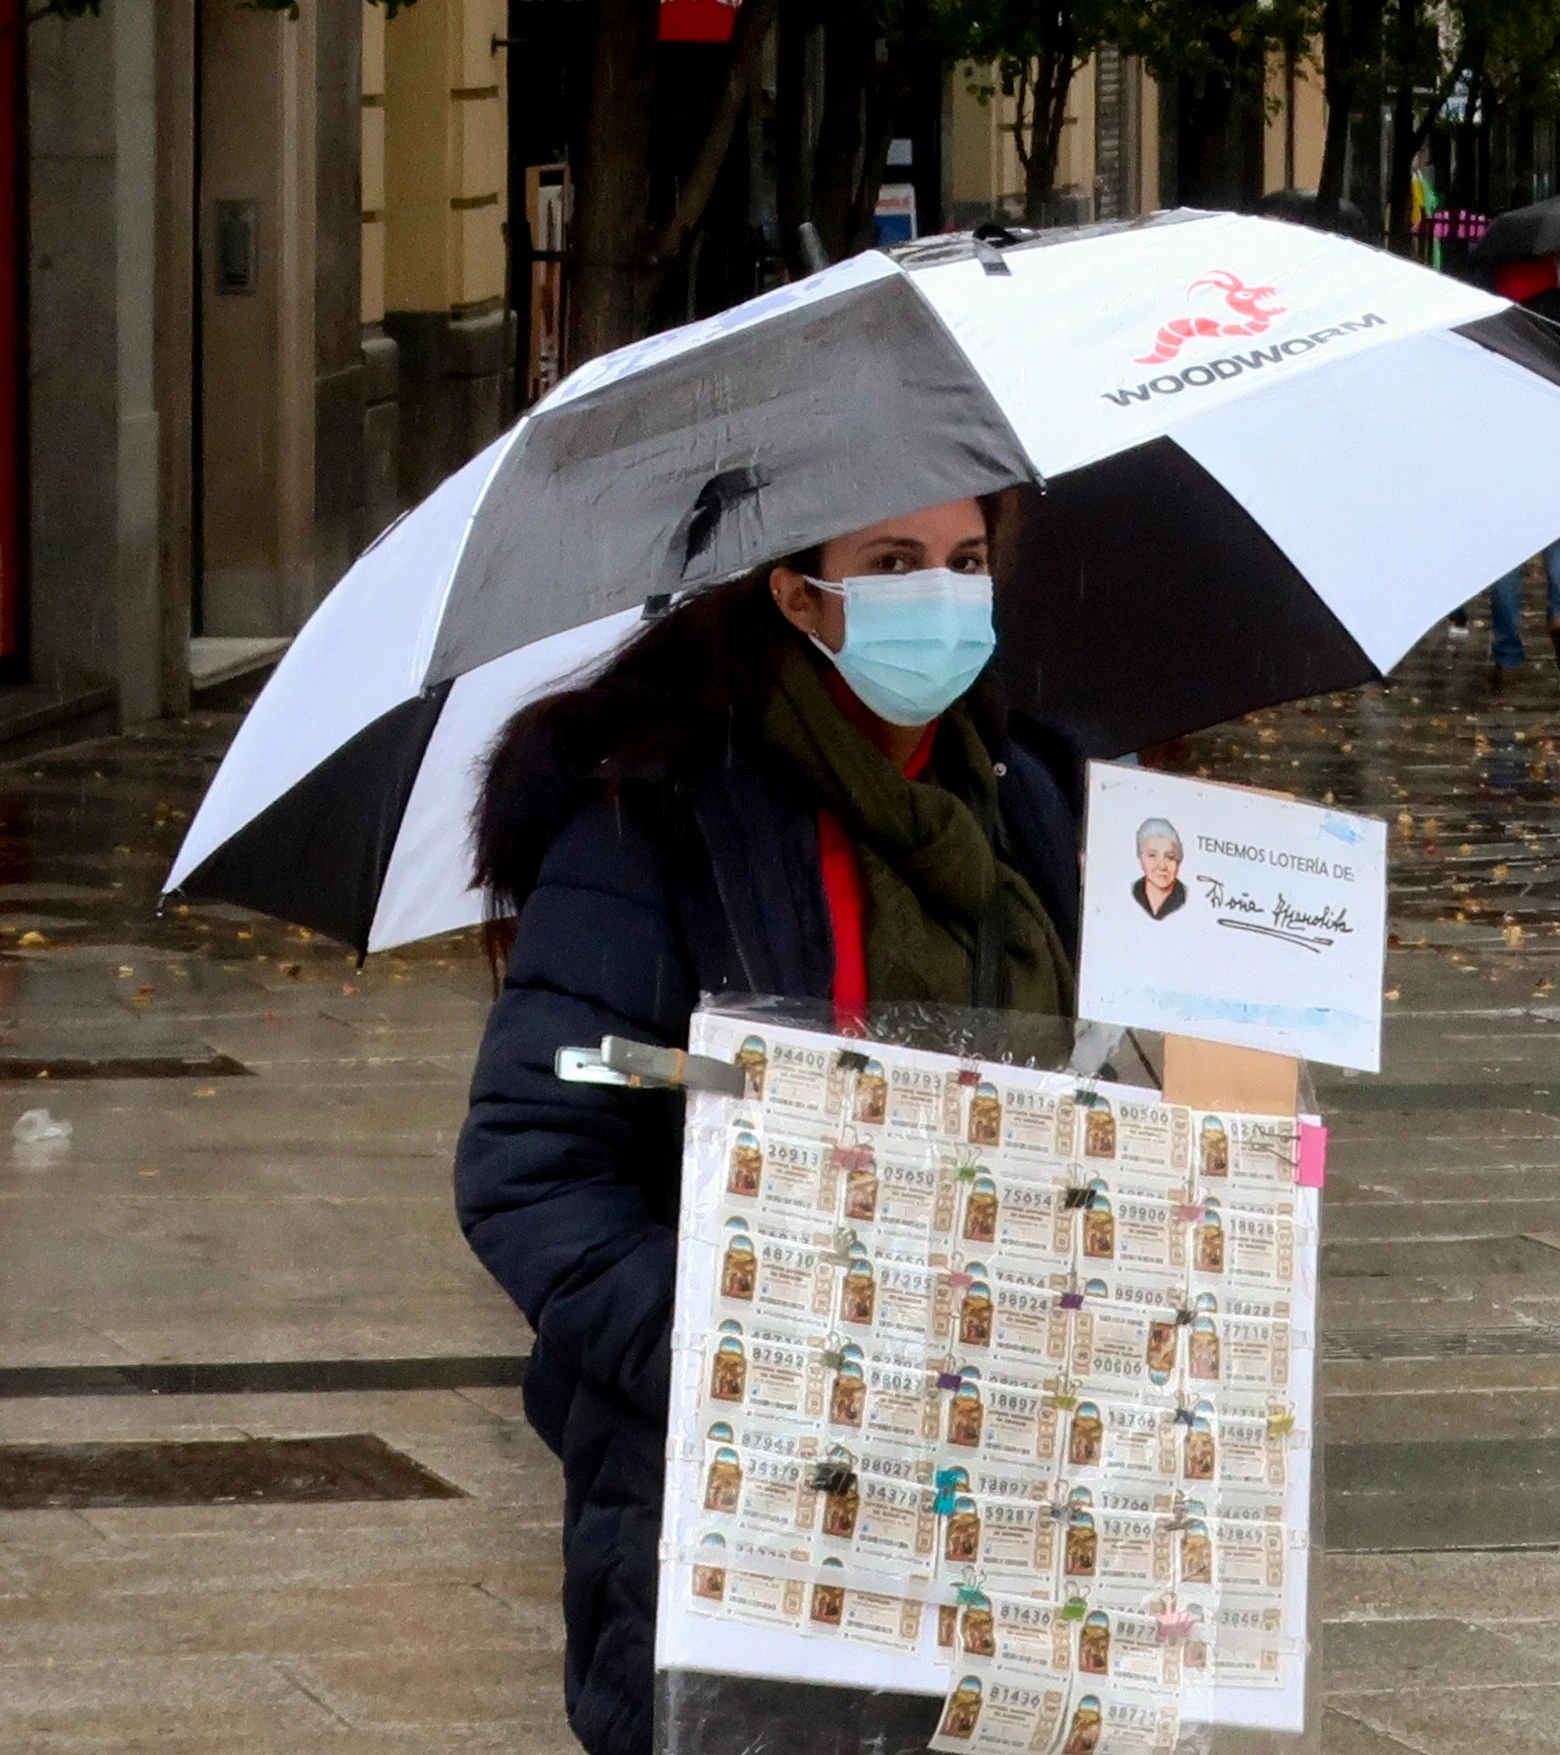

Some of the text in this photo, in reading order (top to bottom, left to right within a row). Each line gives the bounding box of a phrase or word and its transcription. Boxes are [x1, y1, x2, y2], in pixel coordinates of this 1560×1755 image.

[1101, 312, 1387, 407] WOODWORM
[1197, 836, 1356, 882] TENEMOS LOTERÍA DE:
[773, 1047, 825, 1068] 94400
[768, 1144, 819, 1166] 26913
[1003, 1189, 1052, 1207] 75654
[762, 1246, 815, 1268] 48710
